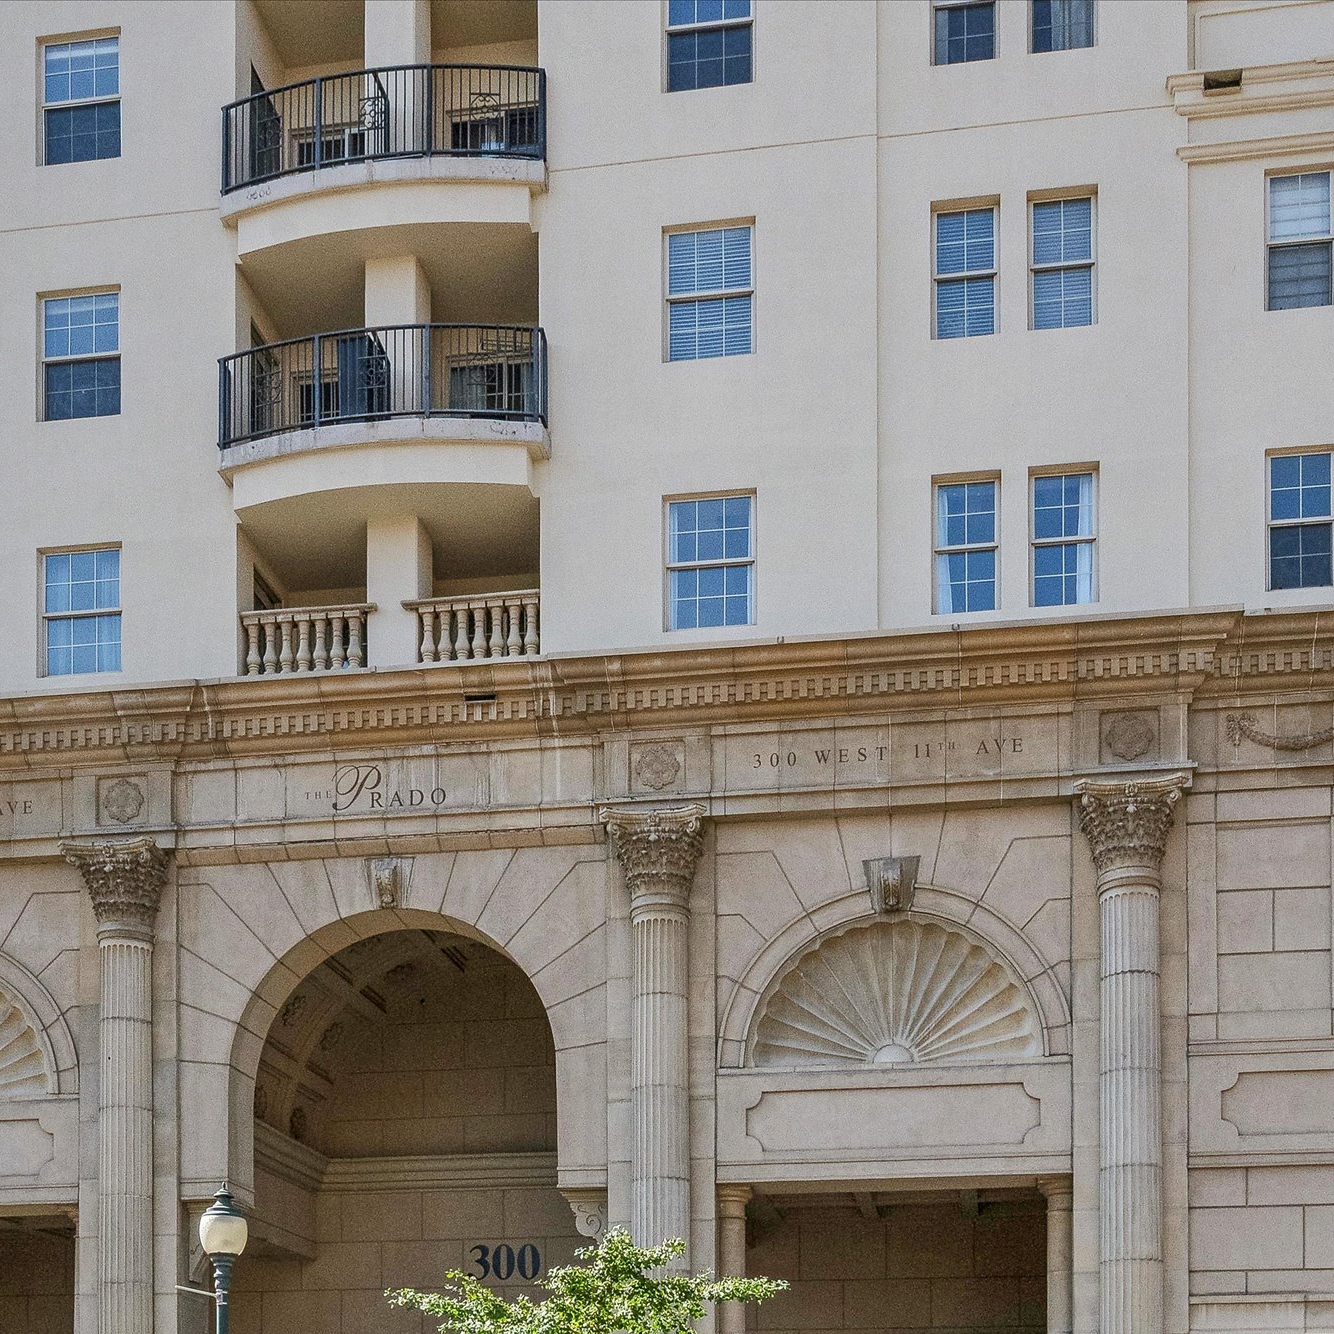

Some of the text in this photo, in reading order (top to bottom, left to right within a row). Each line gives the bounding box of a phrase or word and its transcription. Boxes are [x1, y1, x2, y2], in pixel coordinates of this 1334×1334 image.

[752, 752, 797, 768] 300
[814, 746, 887, 764] WEST
[976, 738, 1024, 755] AVE
[305, 764, 446, 811] THE PRADO
[467, 1243, 540, 1280] 300
